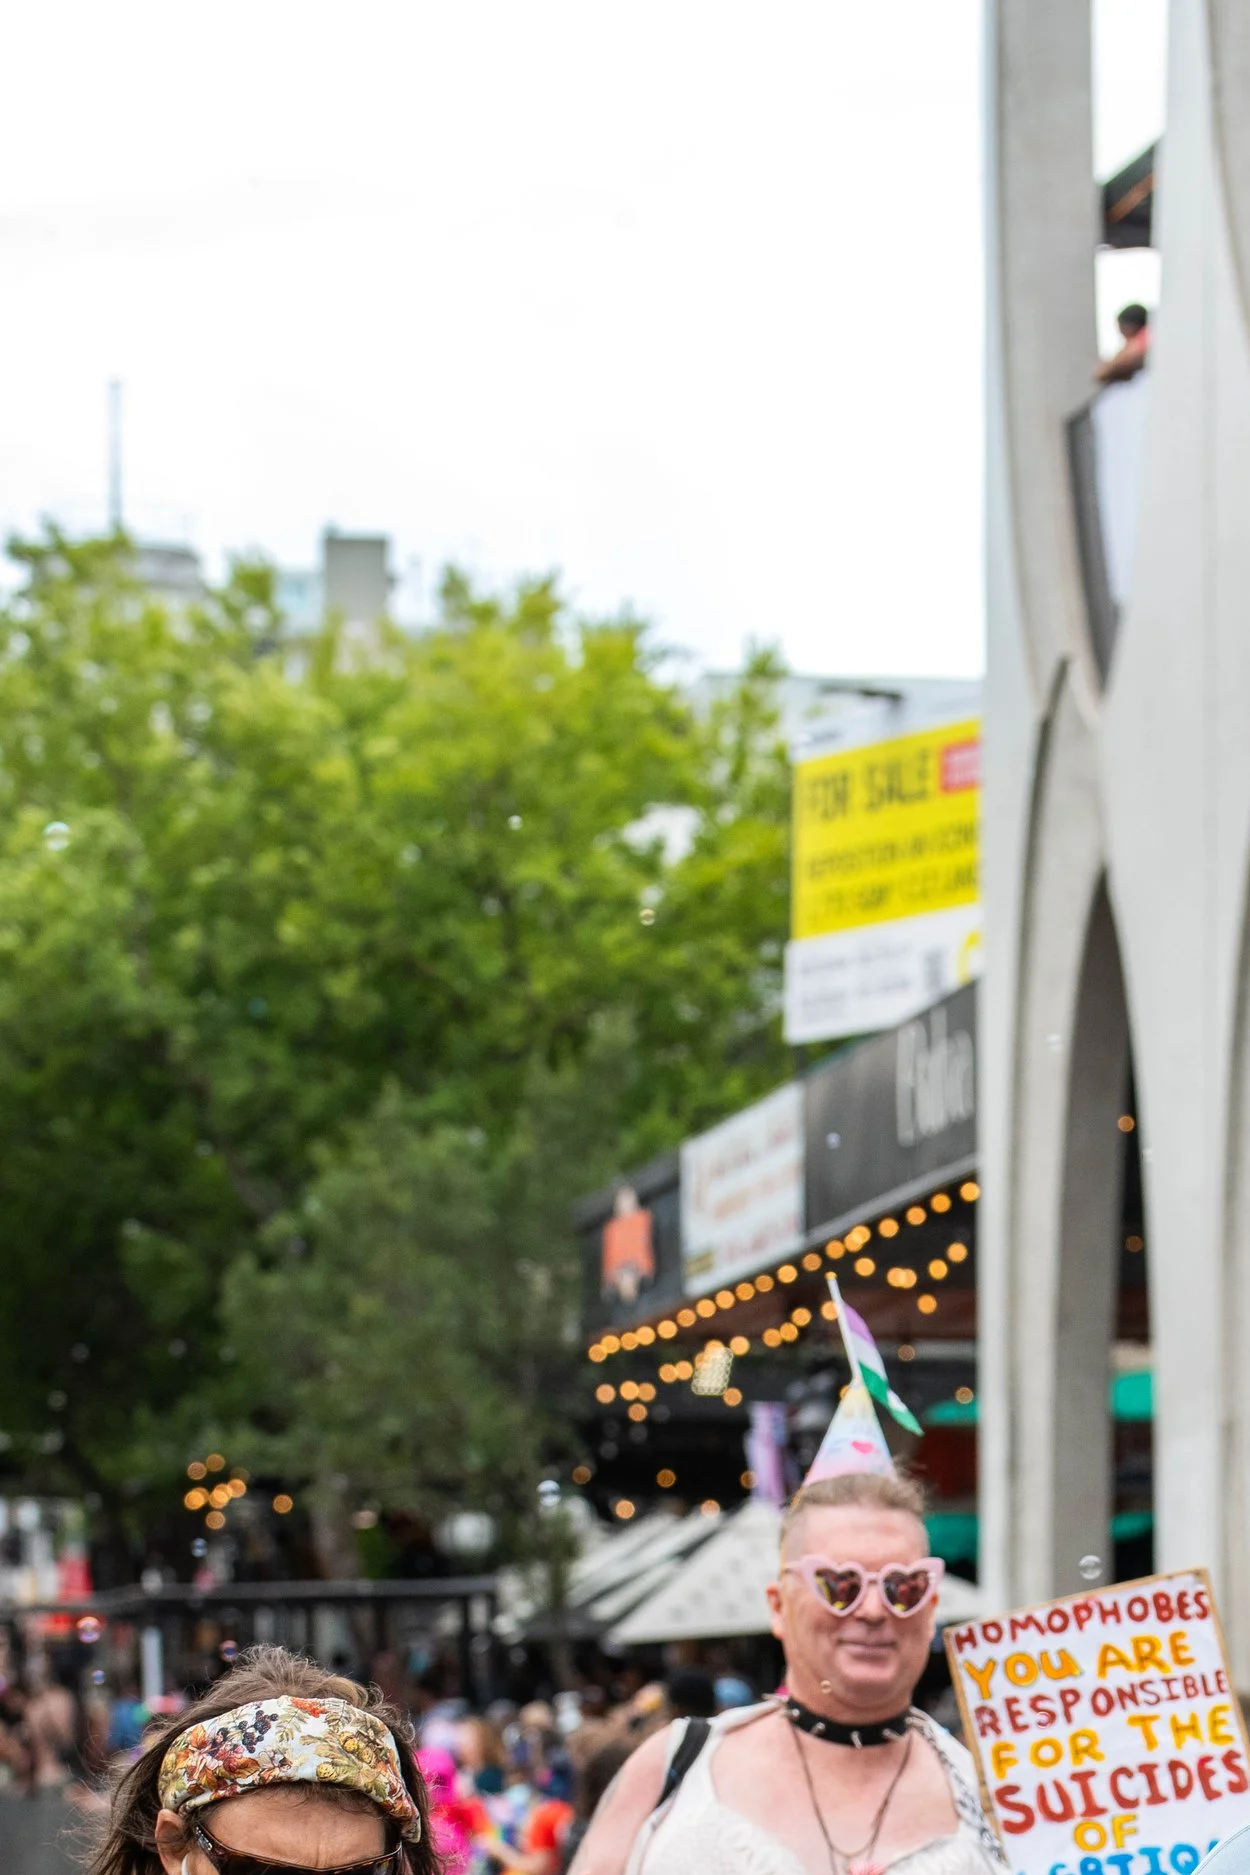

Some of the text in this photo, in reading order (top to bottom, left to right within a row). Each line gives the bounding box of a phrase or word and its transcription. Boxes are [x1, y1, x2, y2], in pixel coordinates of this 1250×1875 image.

[954, 1590, 1210, 1654] HOMOPHOBES
[963, 1630, 1197, 1700] YOU ARE
[974, 1669, 1228, 1739] RESPONSIBLE
[990, 1704, 1235, 1780] FOR THE
[994, 1750, 1250, 1836] SUICIDES
[1073, 1813, 1139, 1853] OF
